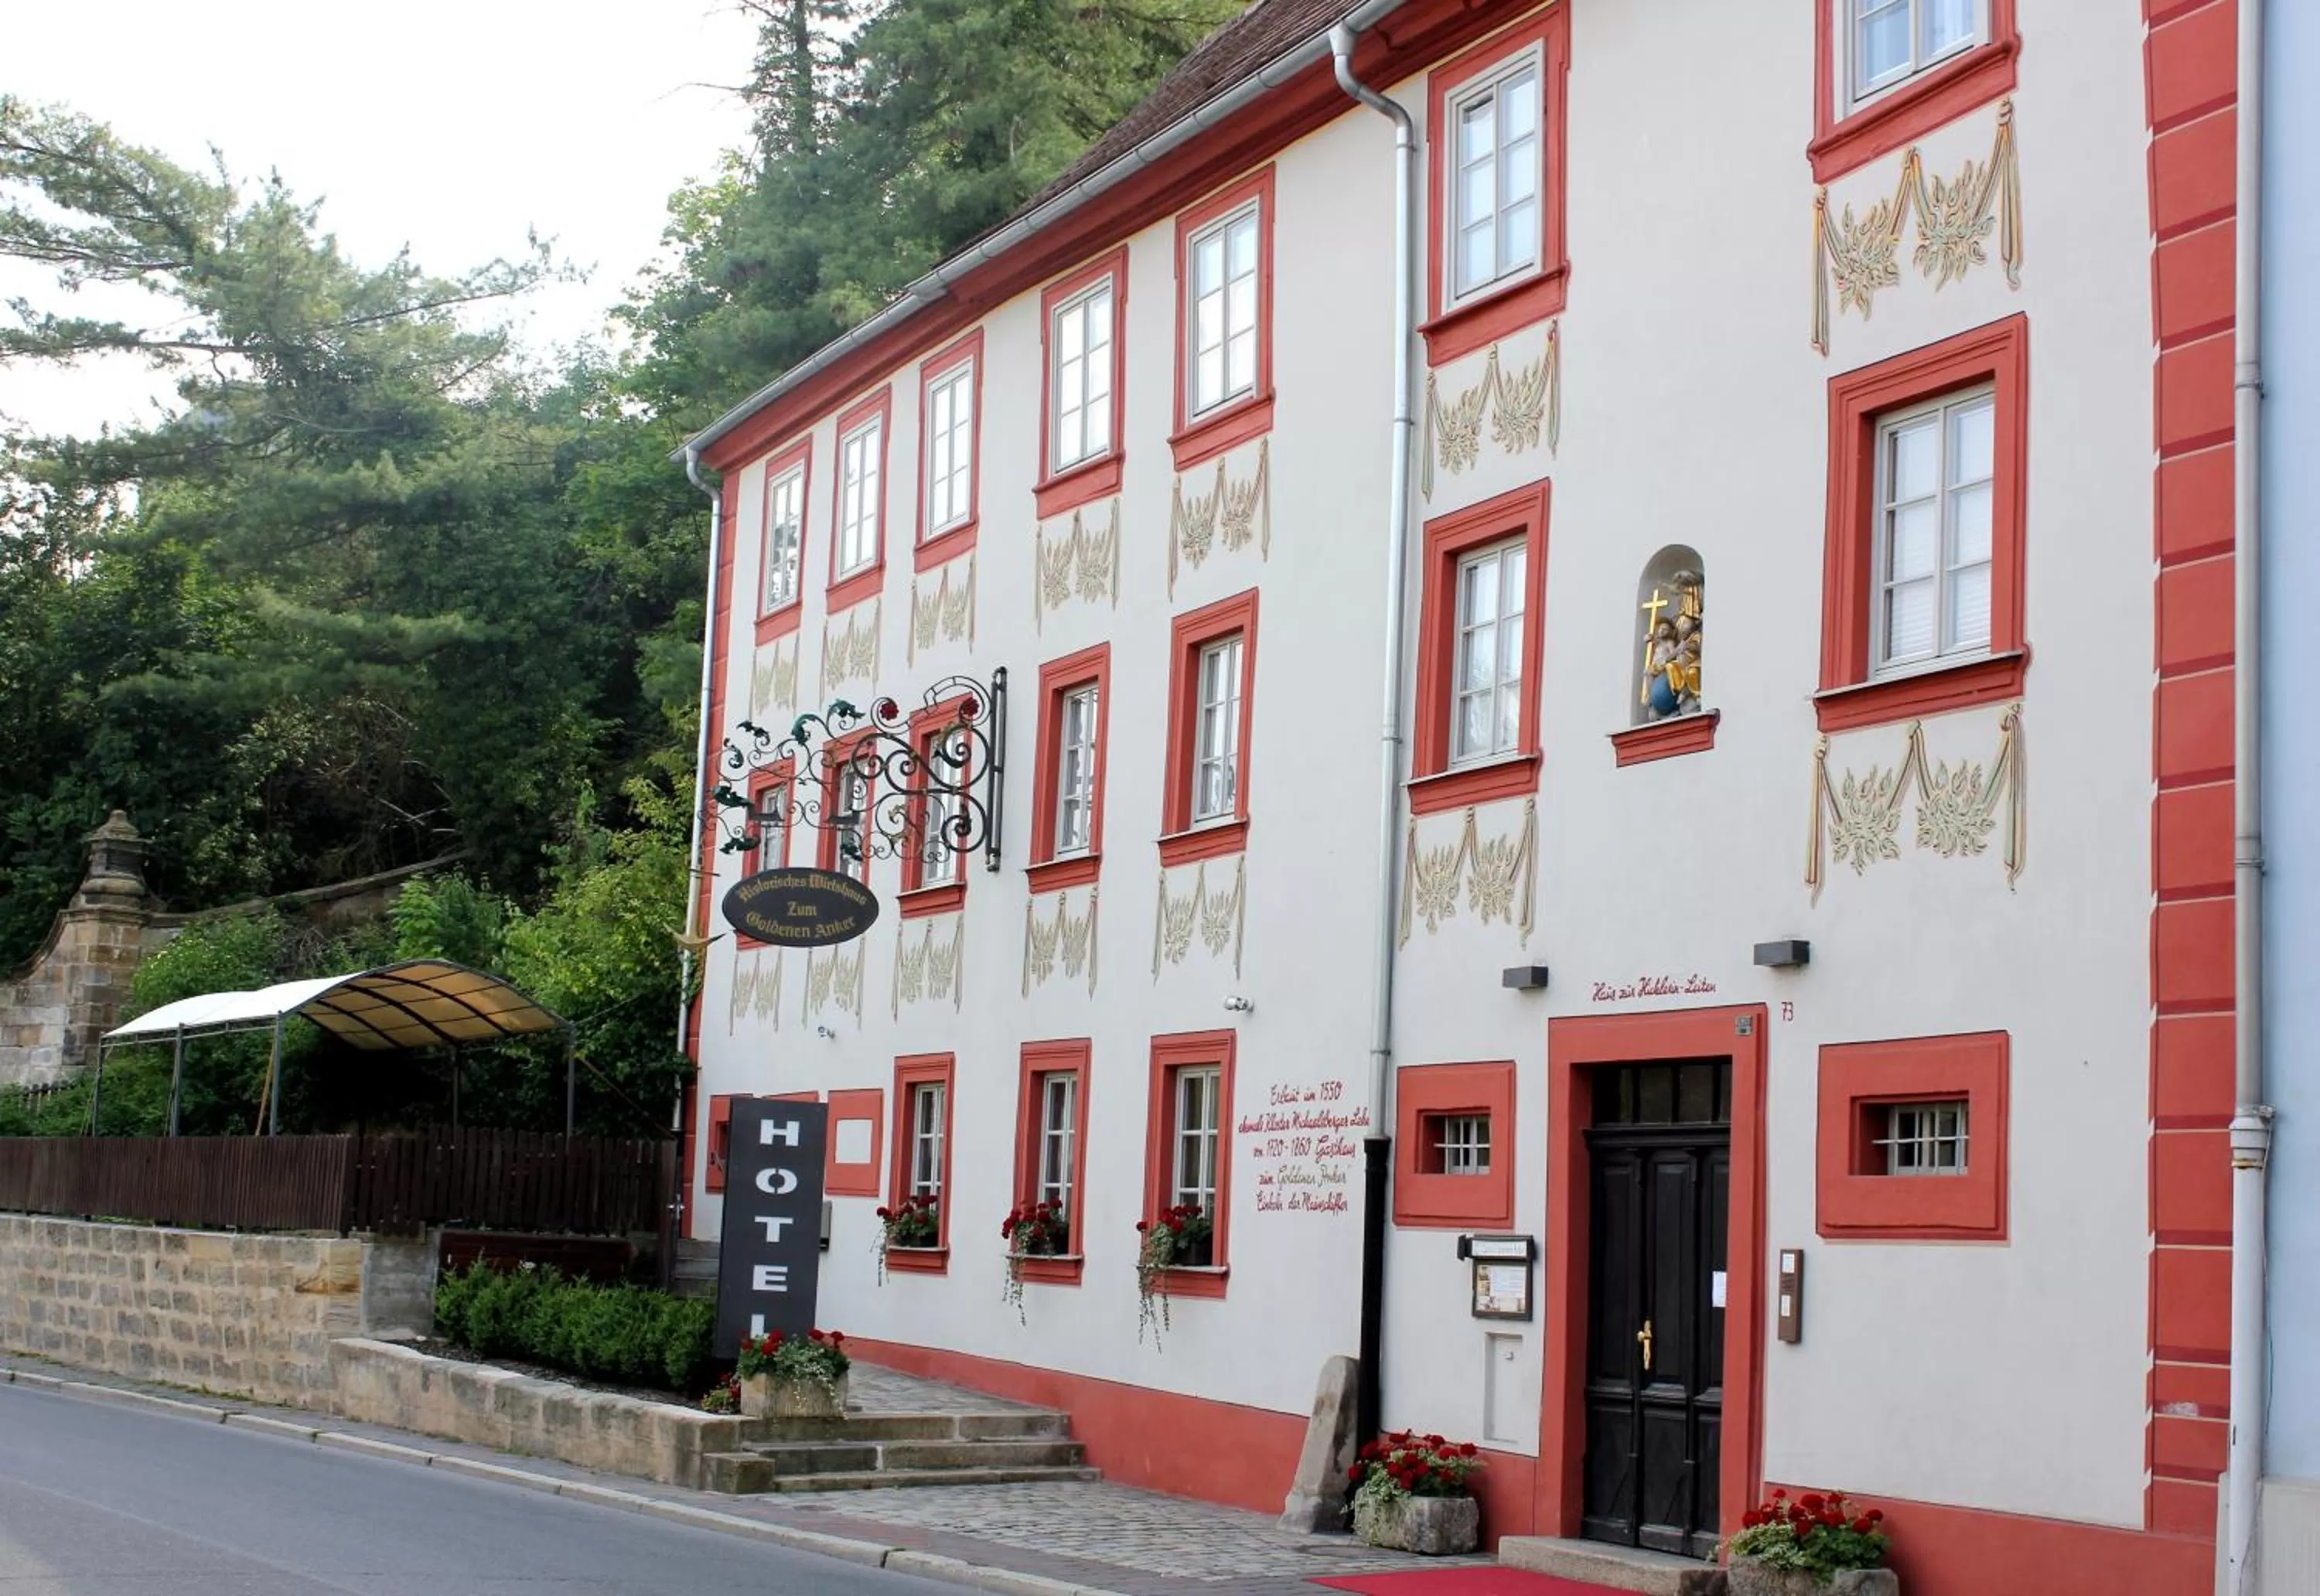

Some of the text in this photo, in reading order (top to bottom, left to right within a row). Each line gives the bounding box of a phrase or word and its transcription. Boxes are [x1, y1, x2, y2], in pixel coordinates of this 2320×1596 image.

[786, 901, 817, 917] Zum
[746, 911, 857, 938] Goldenen Anker
[1781, 1001, 1794, 1021] 73
